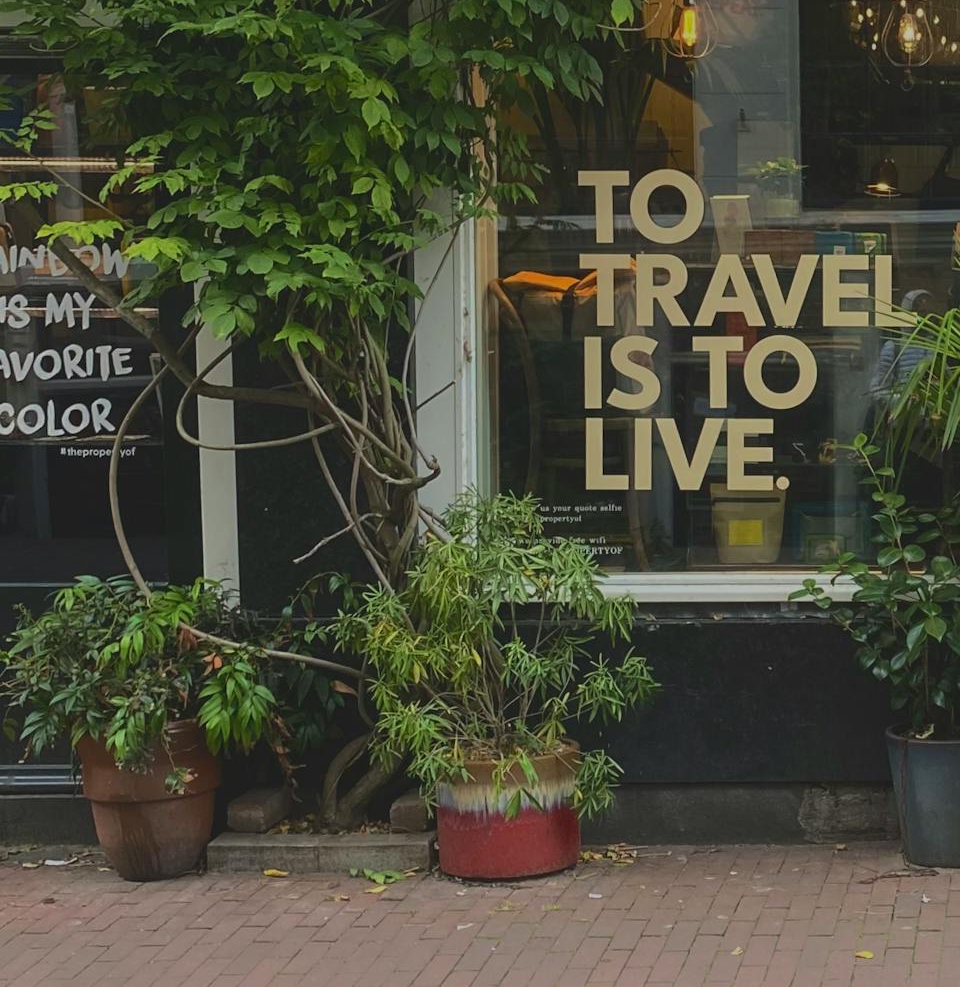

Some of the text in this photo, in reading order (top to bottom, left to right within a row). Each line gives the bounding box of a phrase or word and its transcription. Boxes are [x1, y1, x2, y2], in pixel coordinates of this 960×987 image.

[577, 167, 705, 245] TO
[45, 291, 97, 330] MY
[579, 253, 920, 328] TRAVEL
[584, 334, 819, 411] IS TO
[60, 446, 137, 459] #thepropeyof
[585, 417, 791, 492] LIVE.
[552, 505, 571, 513] your
[574, 504, 598, 513] quote
[588, 535, 606, 544] wifi
